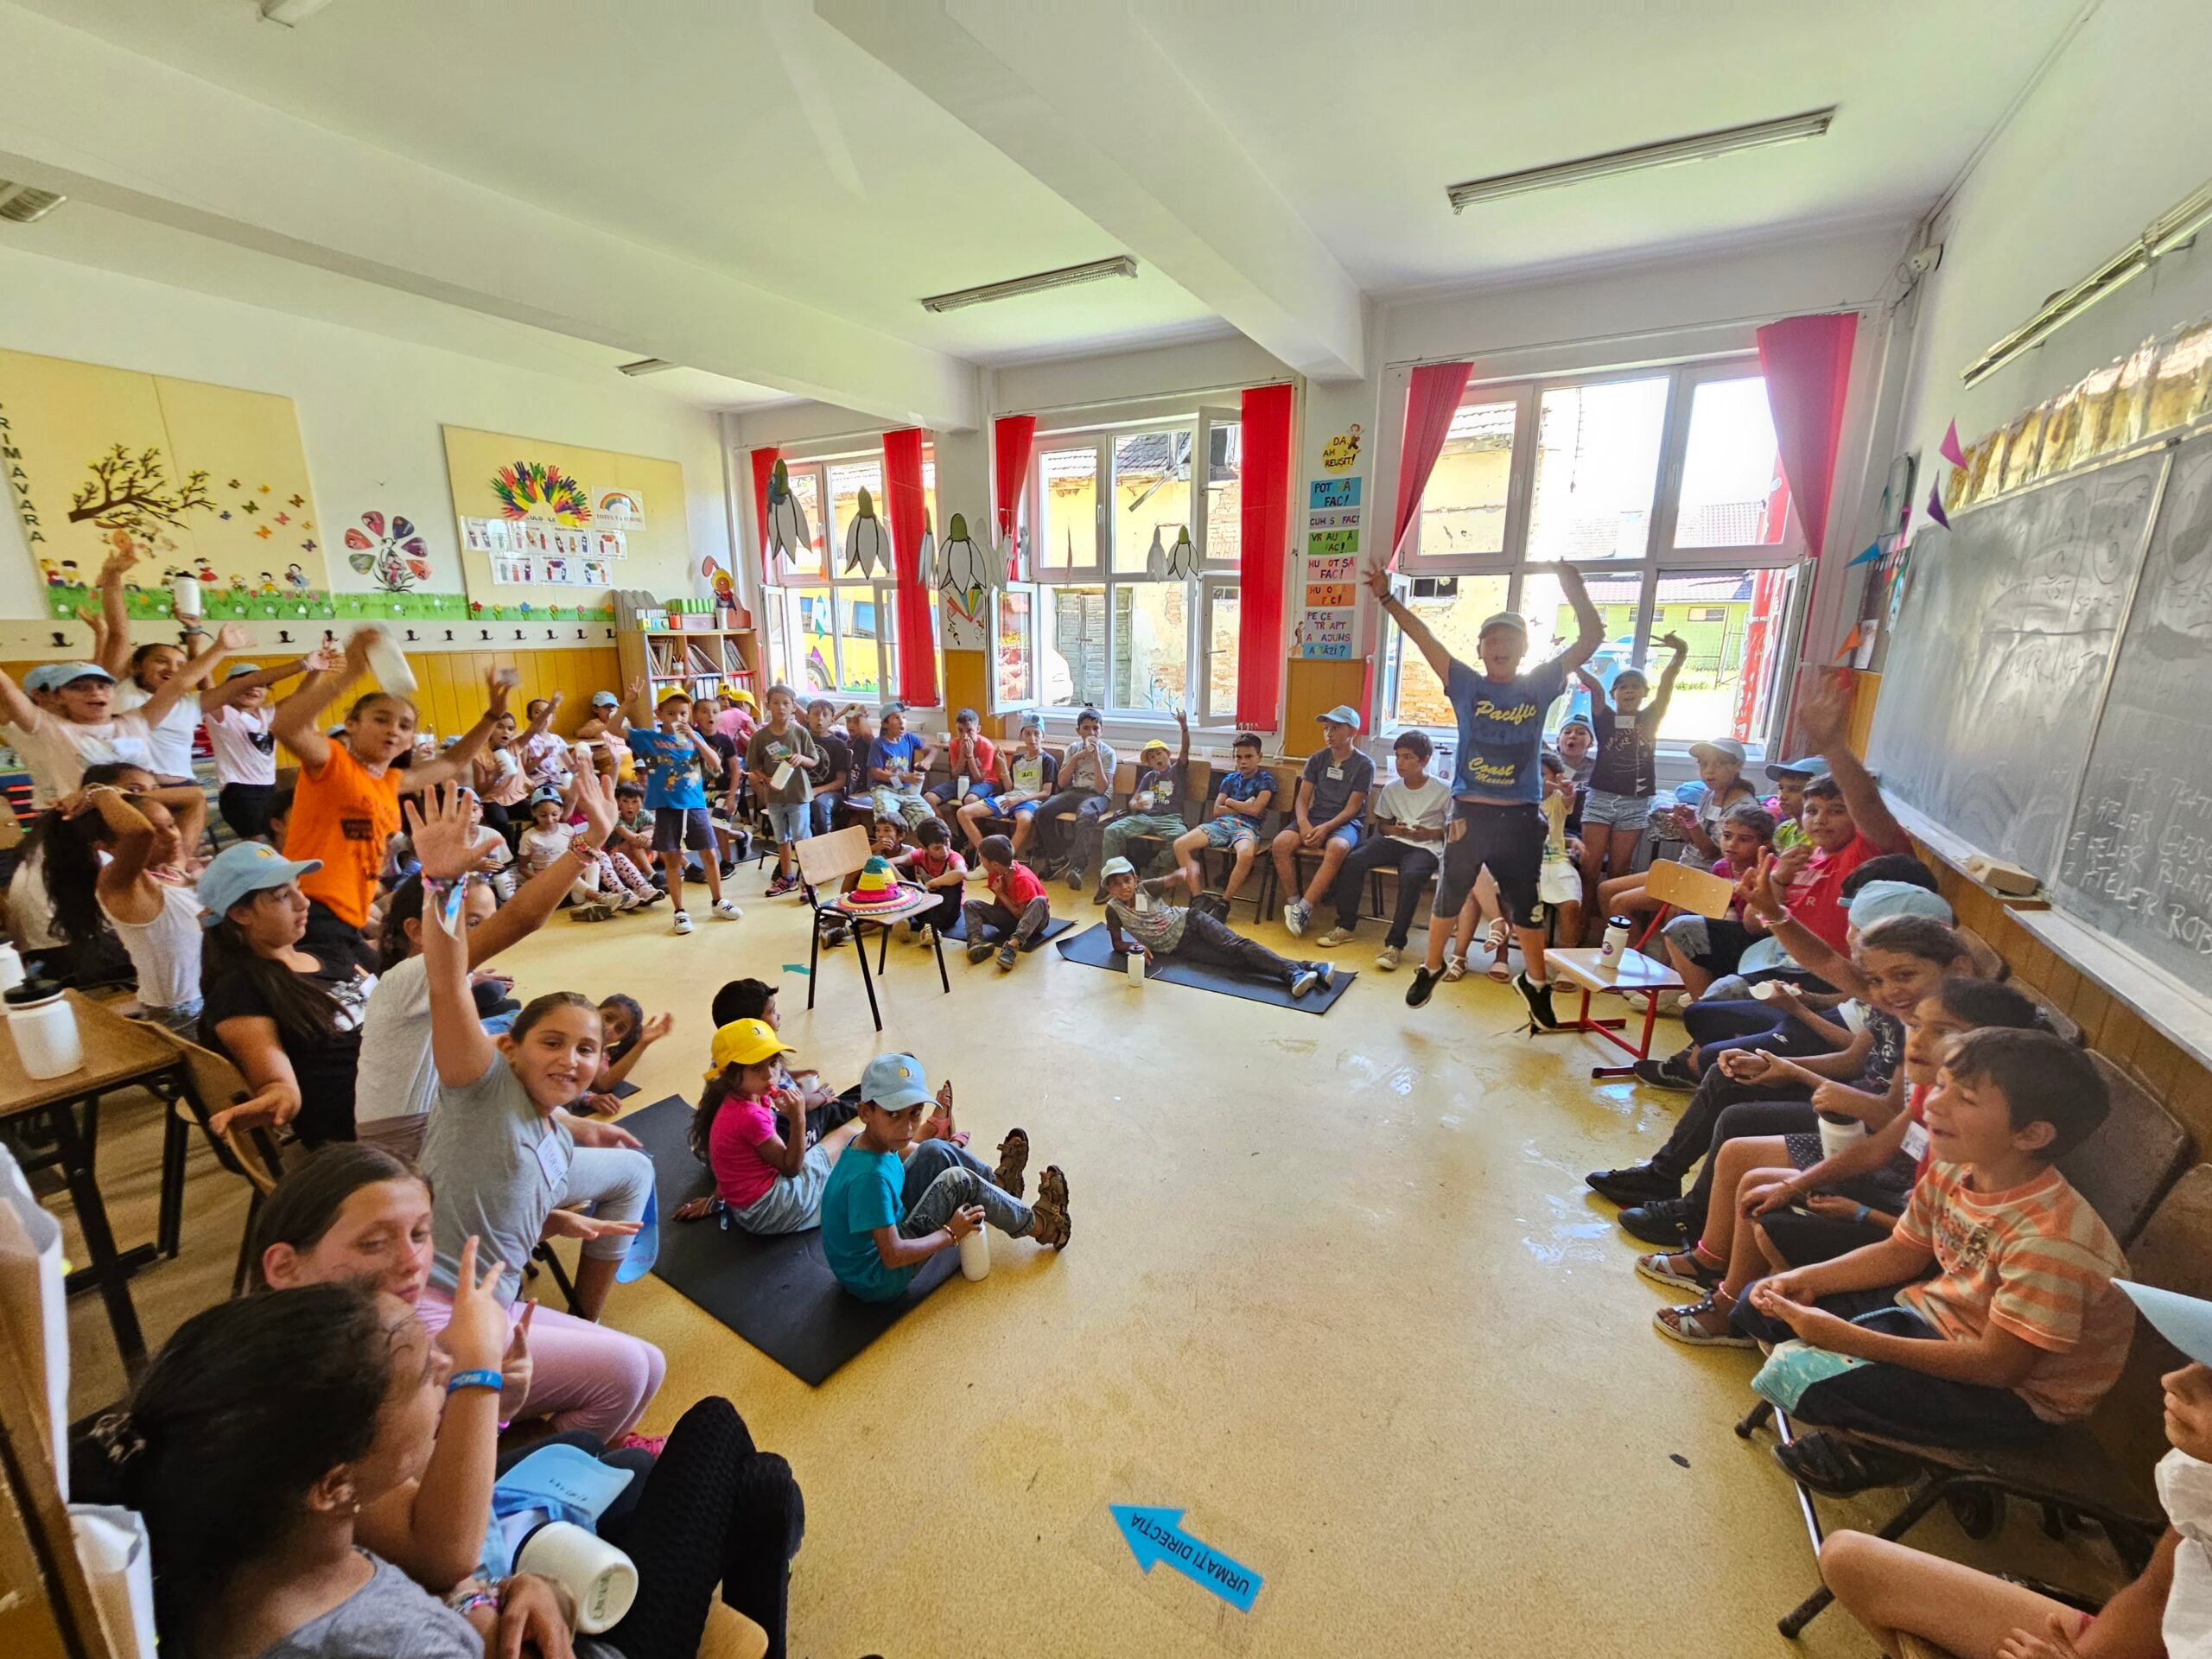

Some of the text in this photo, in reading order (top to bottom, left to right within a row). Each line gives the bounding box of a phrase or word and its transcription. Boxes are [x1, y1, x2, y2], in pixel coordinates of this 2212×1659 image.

[1333, 436, 1346, 446] DA
[0, 404, 46, 542] RIMĂVARA
[1314, 482, 1332, 493] POT
[1324, 494, 1350, 507] FAC!
[1311, 532, 1338, 542] VRAU
[1320, 569, 1344, 580] FAC!
[1322, 594, 1342, 605] FC!
[1306, 612, 1333, 621] PE CE
[1475, 700, 1537, 725] Pacific
